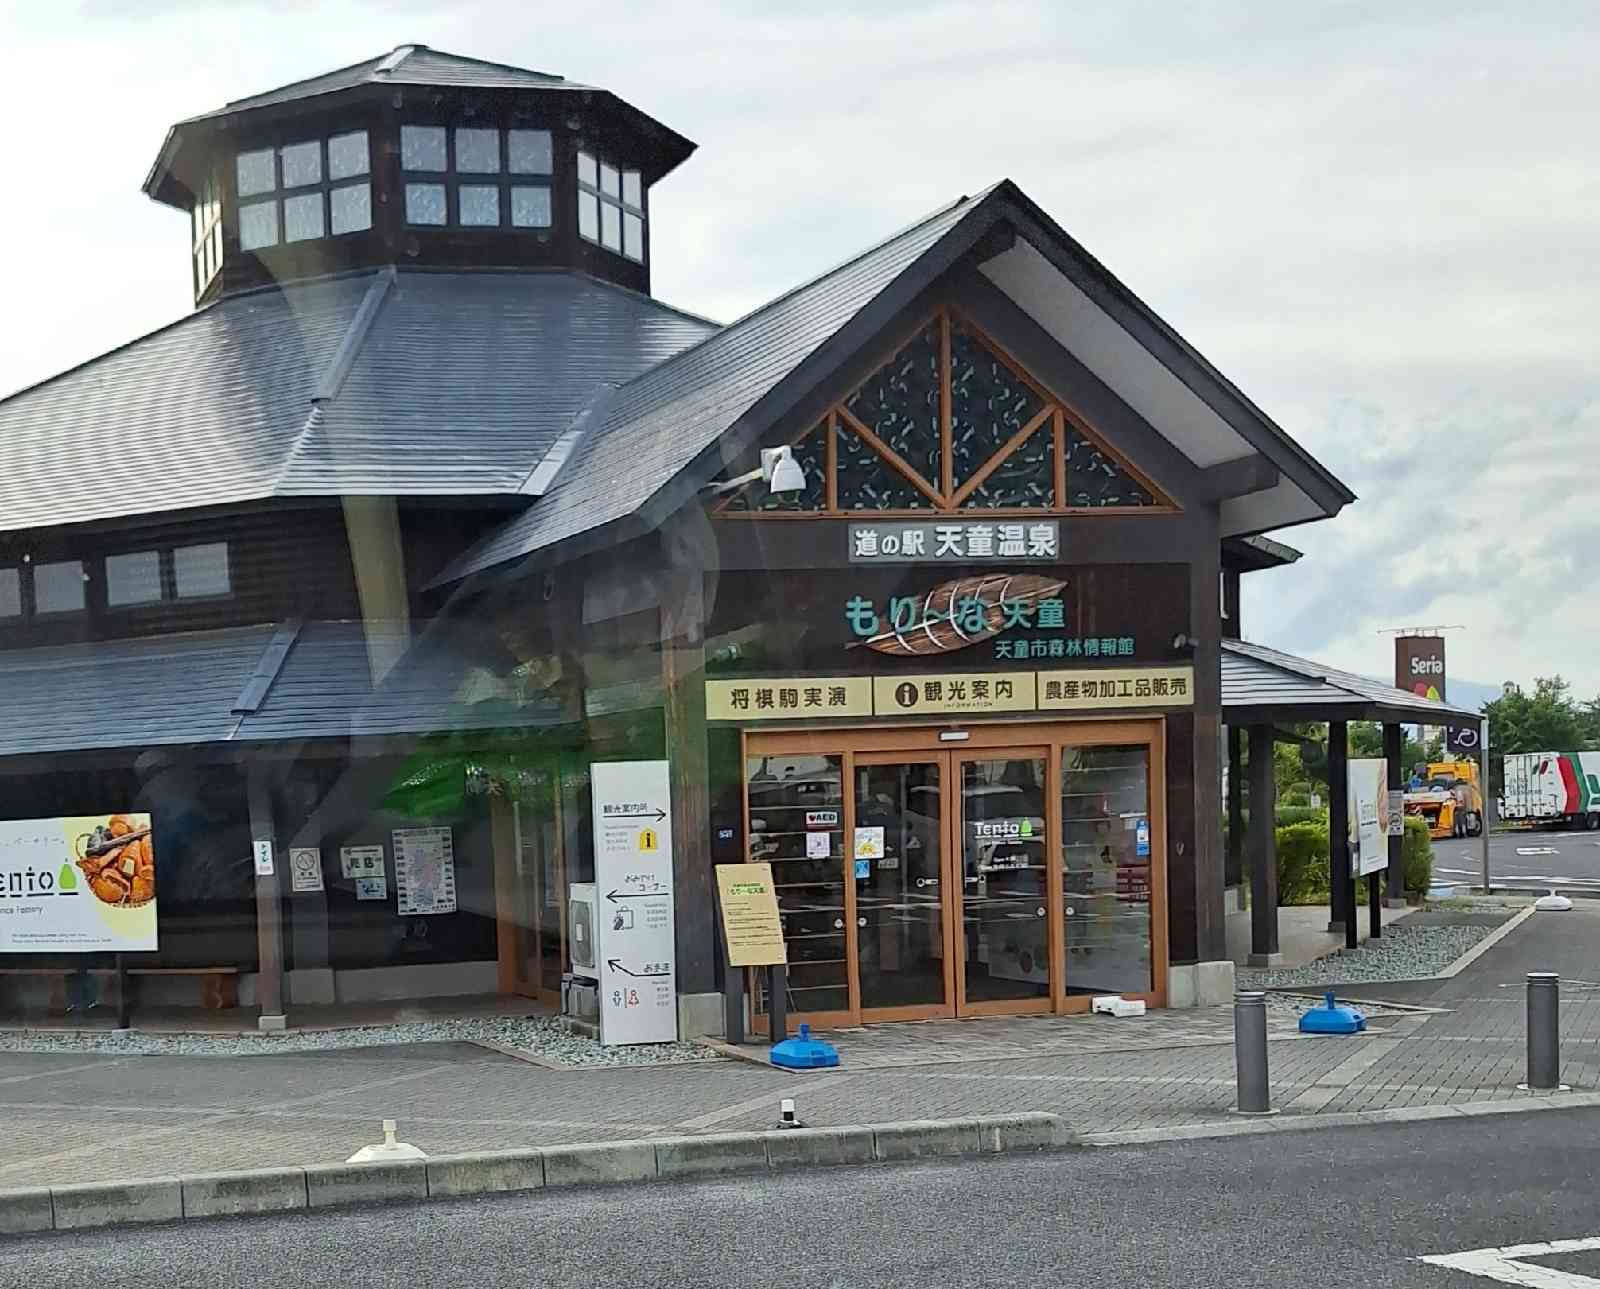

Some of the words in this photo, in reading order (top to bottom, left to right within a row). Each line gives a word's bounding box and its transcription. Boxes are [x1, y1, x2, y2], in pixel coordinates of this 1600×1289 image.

[855, 529, 925, 558] 道の駅
[934, 524, 1056, 557] 天童温泉
[994, 638, 1136, 659] 天童市森林情報館
[1411, 655, 1444, 675] Seria
[730, 686, 848, 710] 将棋駒実演
[924, 680, 1013, 701] 観光案内
[1045, 678, 1187, 700] 農産物加工品販売
[816, 813, 836, 822] AED
